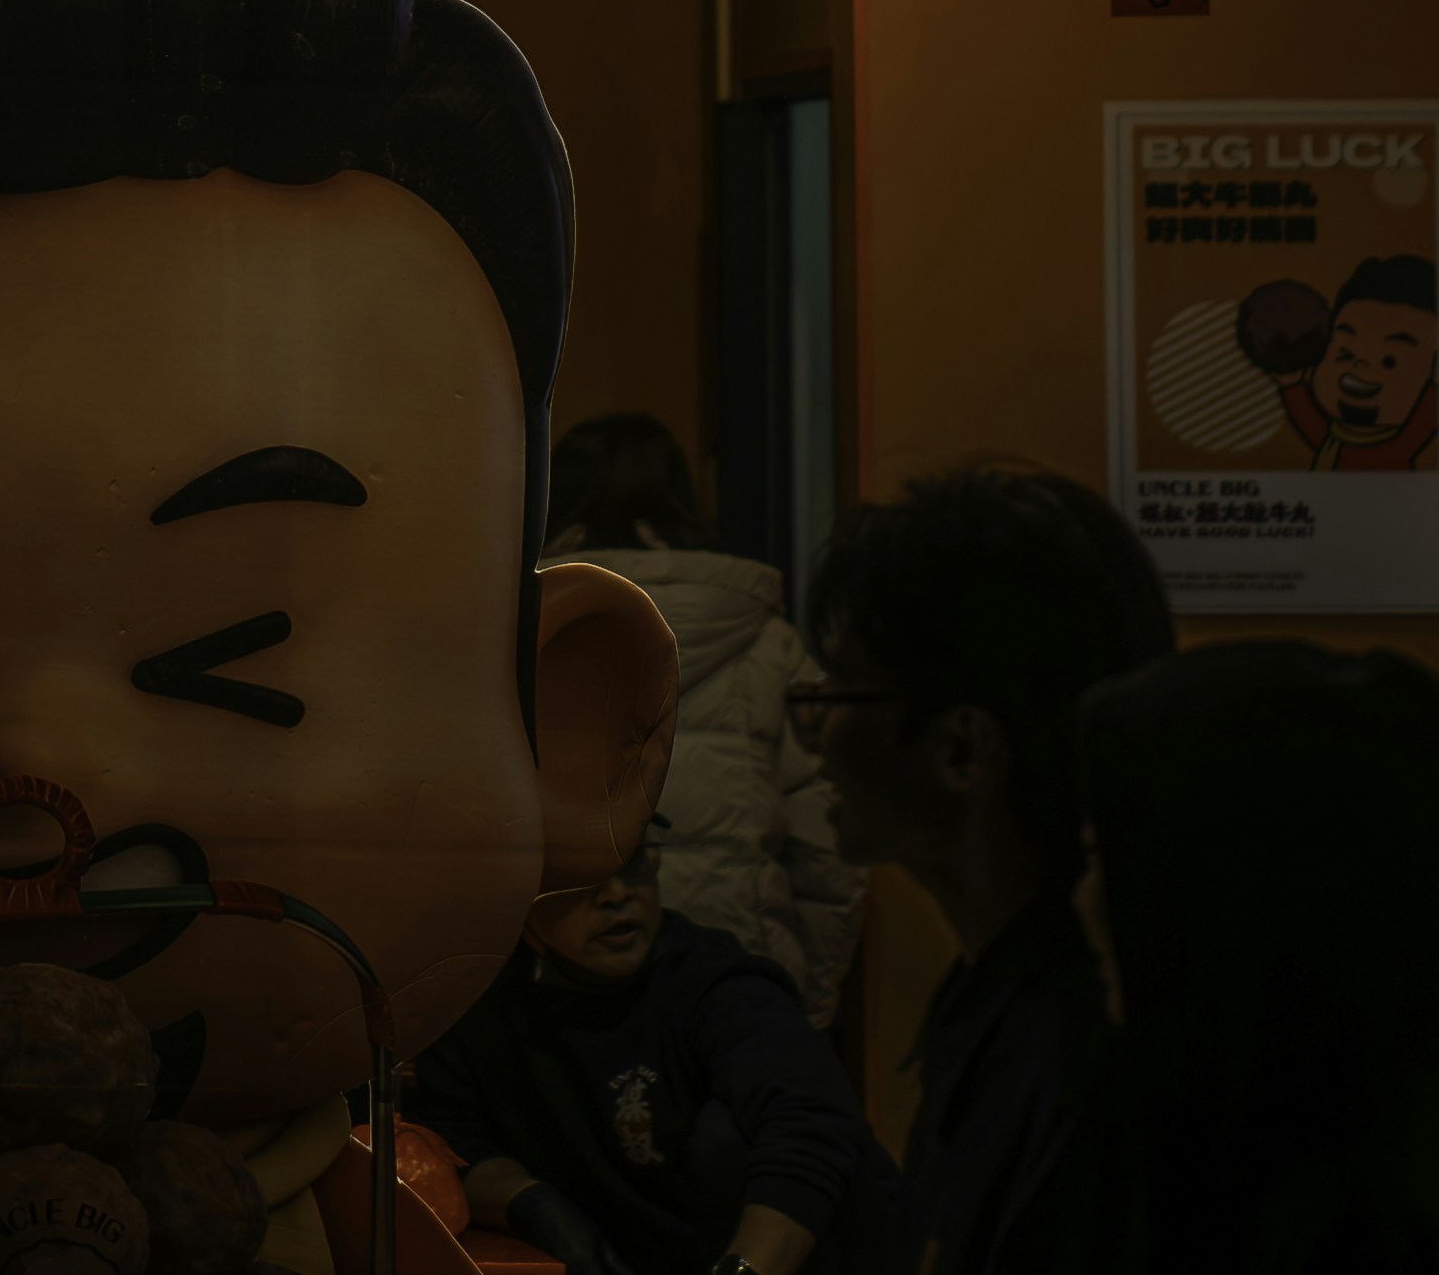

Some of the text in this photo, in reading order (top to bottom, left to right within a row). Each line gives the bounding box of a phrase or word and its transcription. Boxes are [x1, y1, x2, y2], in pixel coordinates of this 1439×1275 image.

[1141, 132, 1427, 170] BIG LUCK
[74, 1202, 126, 1244] BIG
